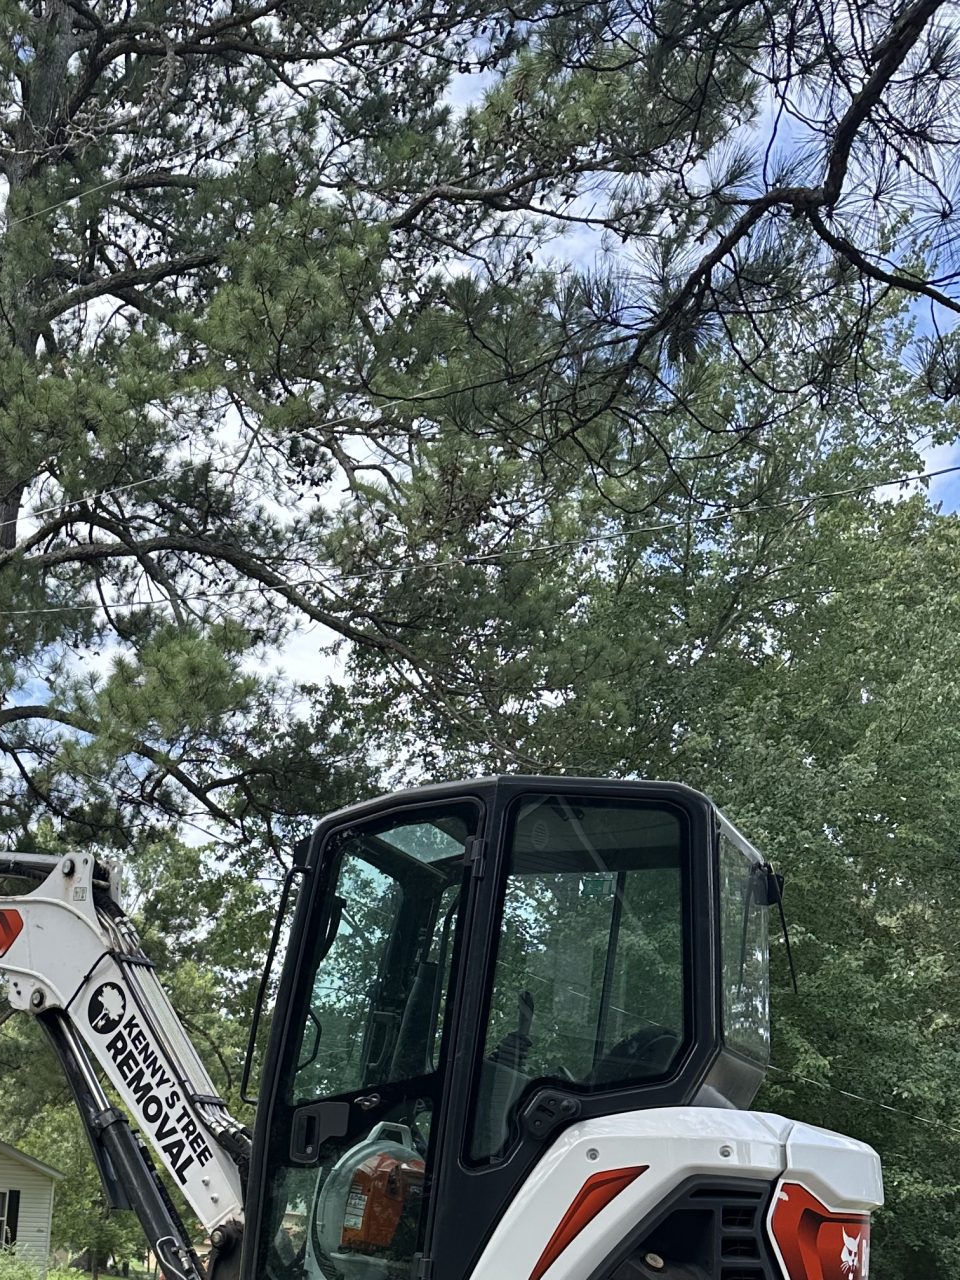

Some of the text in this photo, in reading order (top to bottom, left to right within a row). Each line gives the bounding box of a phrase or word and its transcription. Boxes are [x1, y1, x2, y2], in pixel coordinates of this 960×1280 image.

[106, 1030, 195, 1186] REMOVAL
[123, 1014, 214, 1168] KENNY'S TREE
